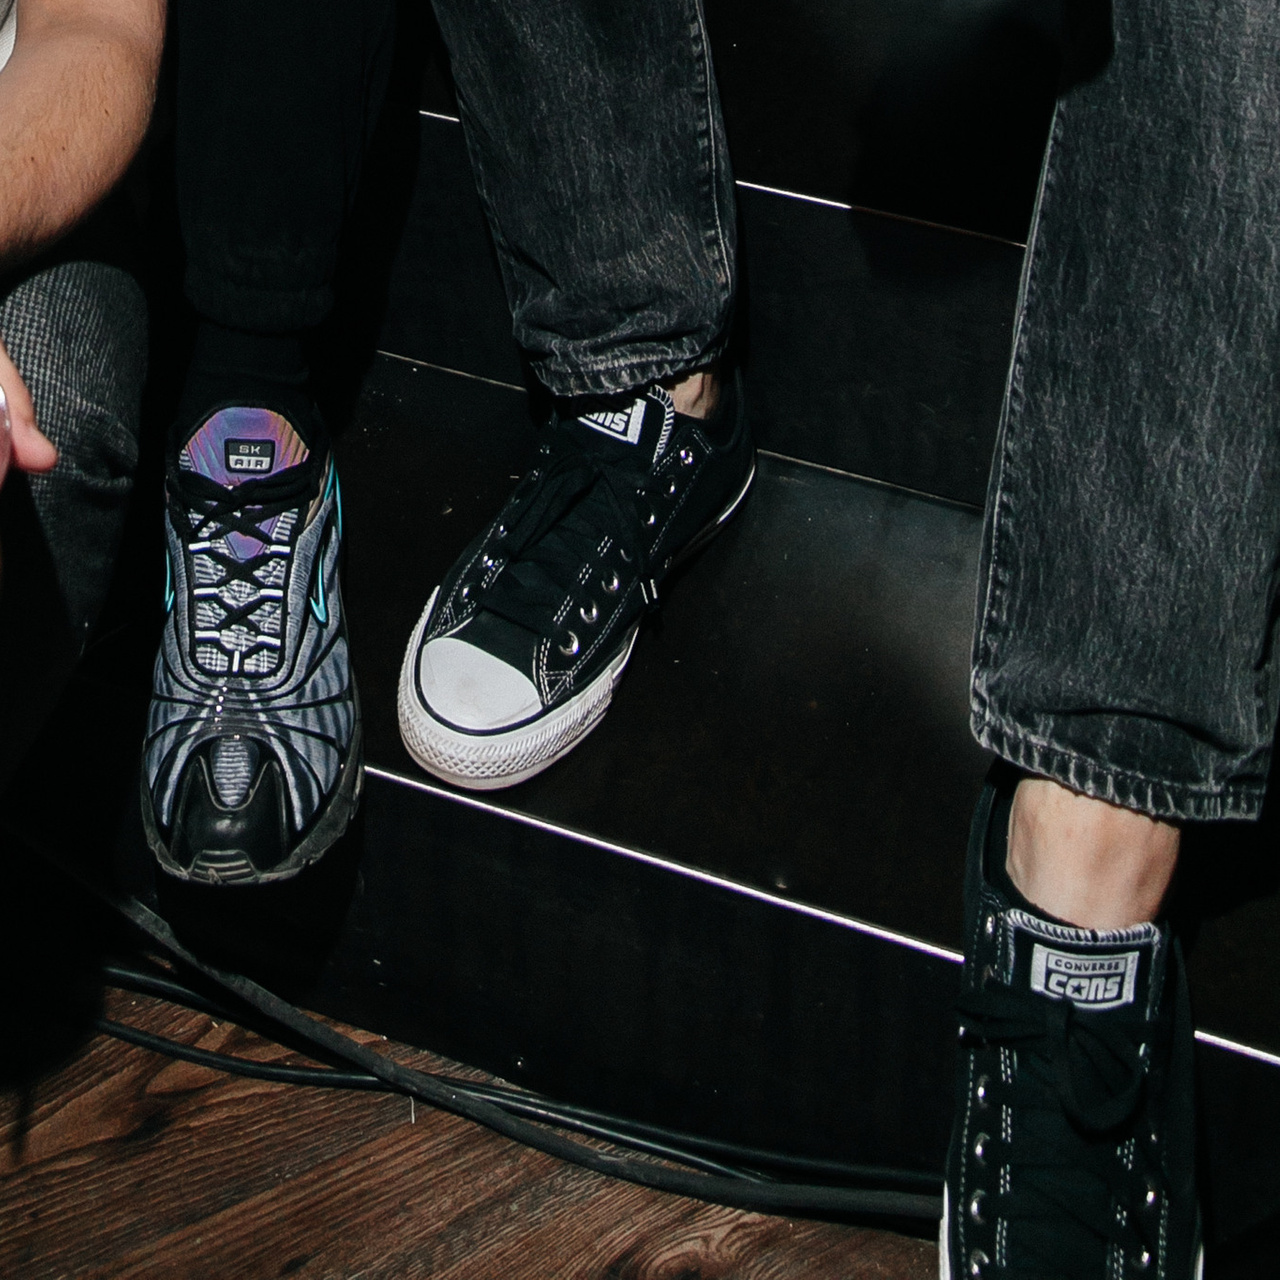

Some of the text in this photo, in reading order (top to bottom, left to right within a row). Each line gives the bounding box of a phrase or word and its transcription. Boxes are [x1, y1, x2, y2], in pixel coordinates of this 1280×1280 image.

[239, 445, 261, 454] SK
[235, 459, 264, 468] AIR
[1055, 959, 1119, 971] CONVERSE
